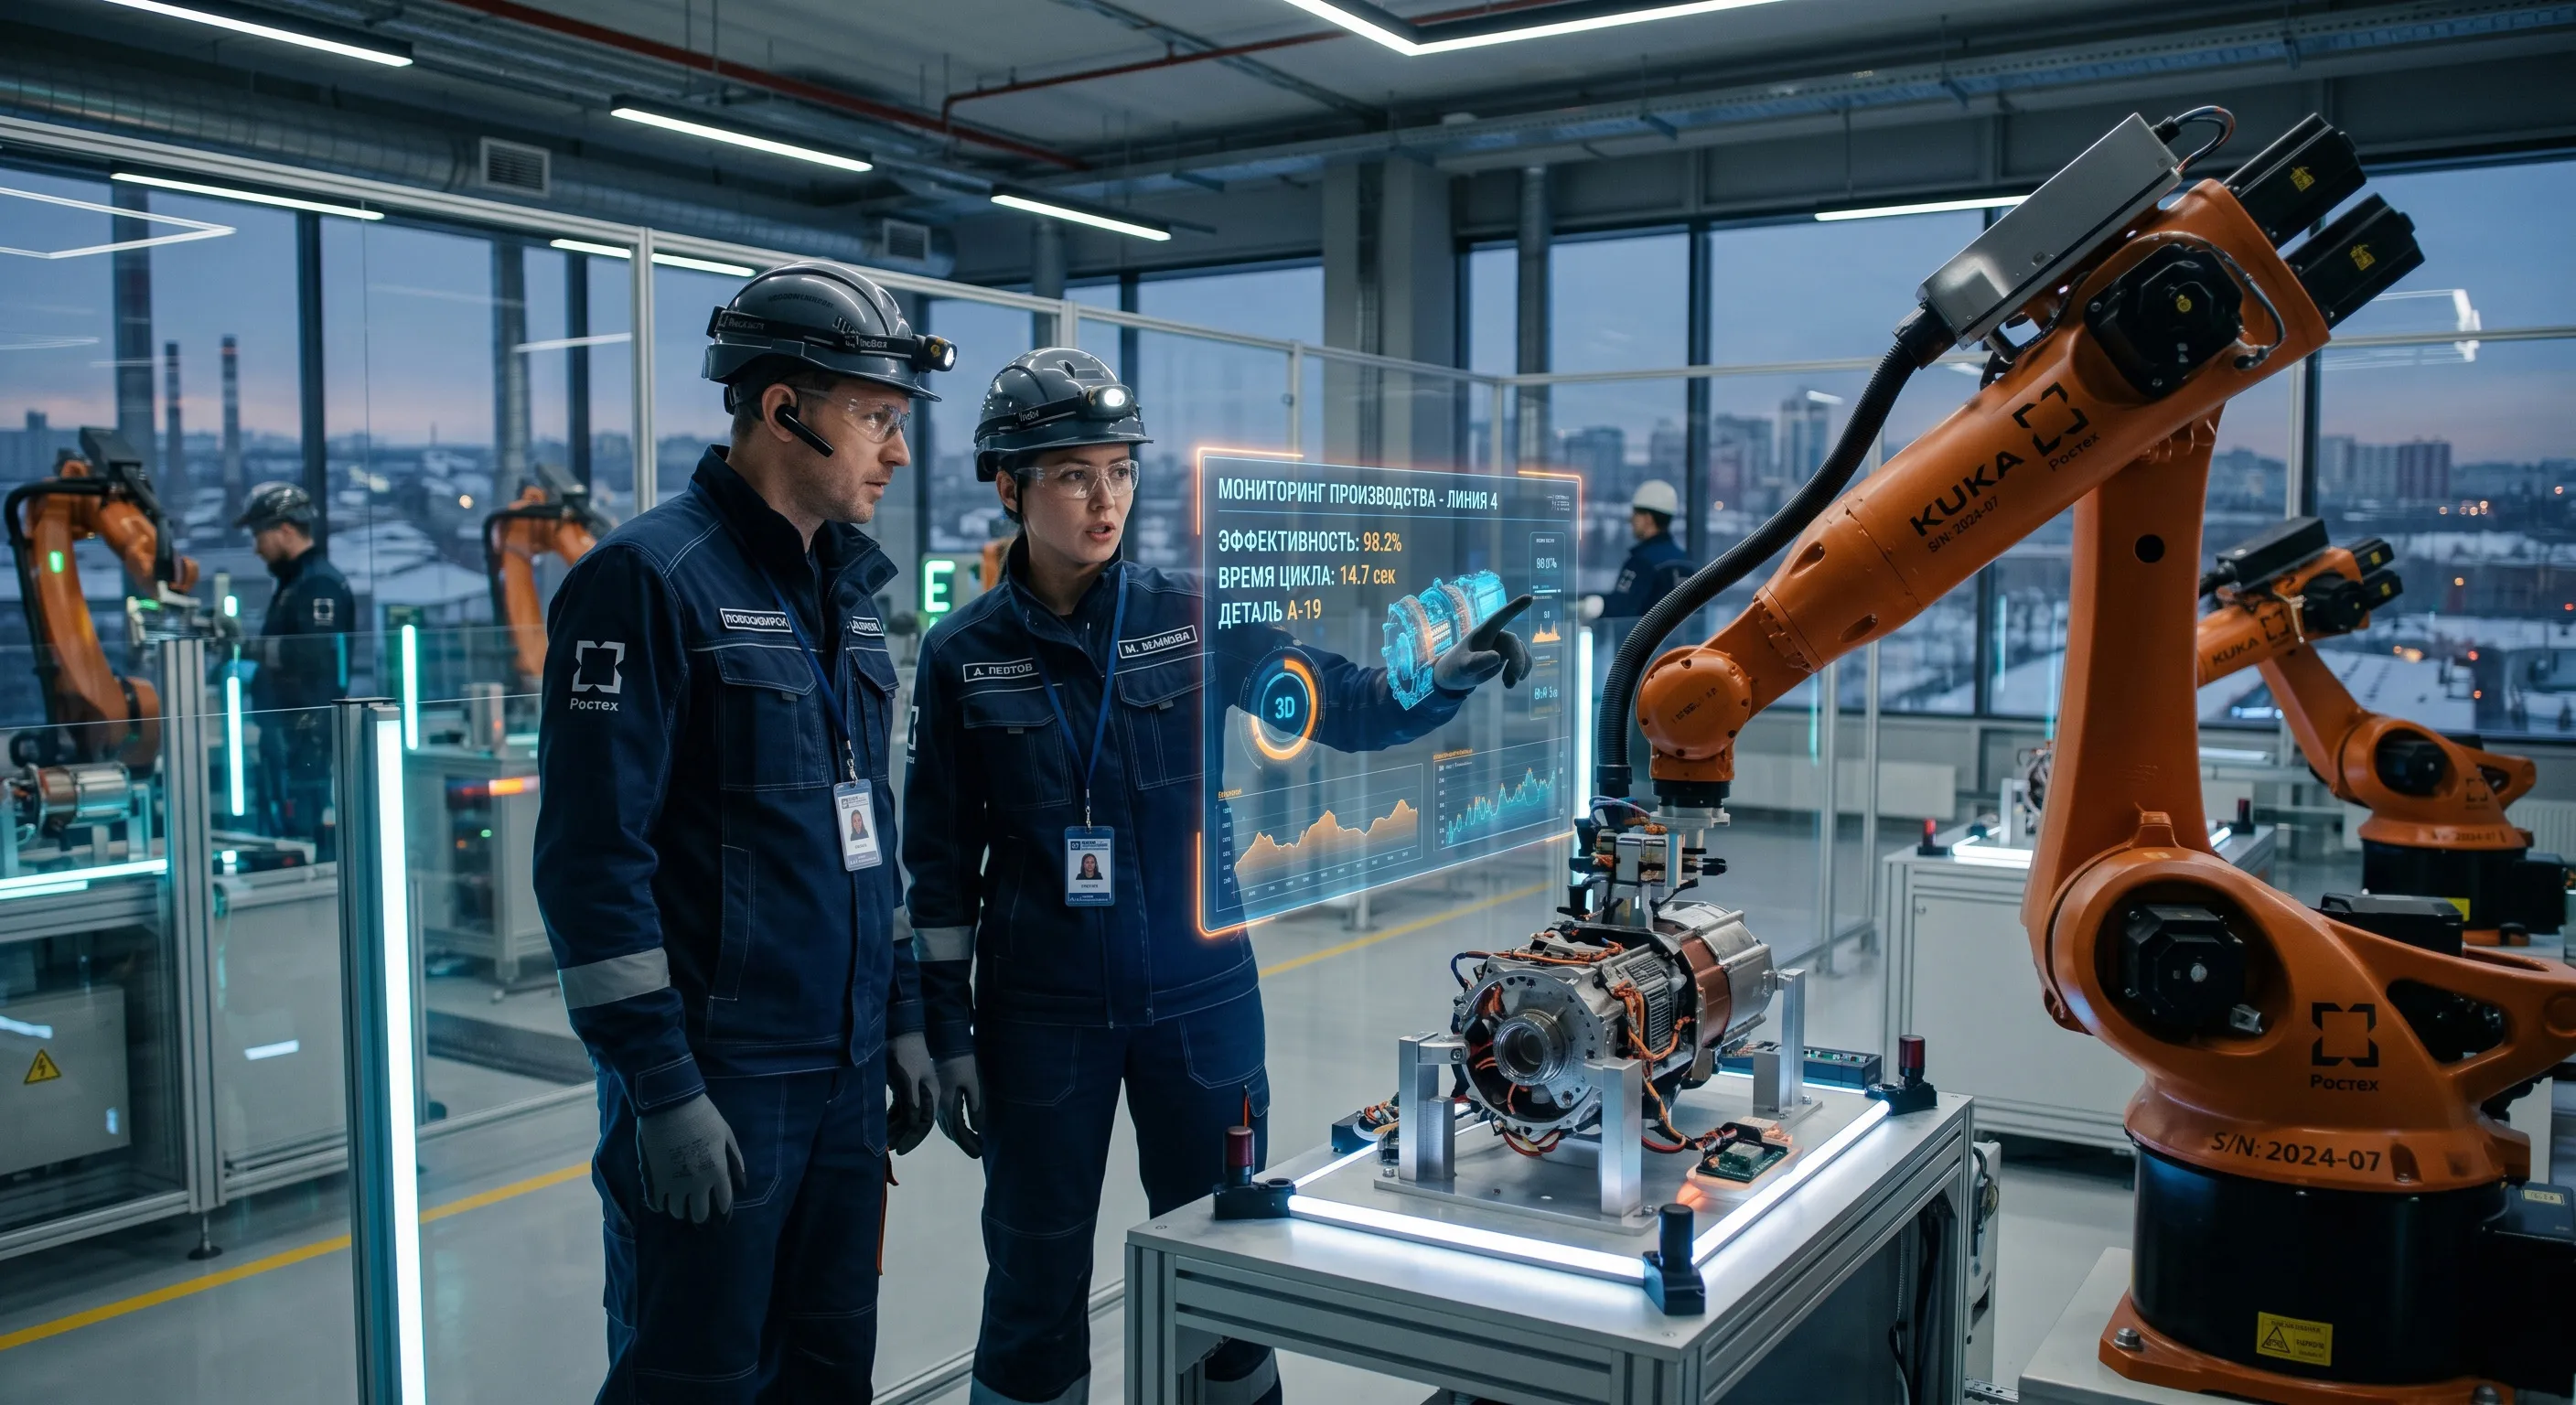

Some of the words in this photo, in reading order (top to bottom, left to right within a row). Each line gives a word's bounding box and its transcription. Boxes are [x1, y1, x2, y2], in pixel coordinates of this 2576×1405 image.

[2048, 432, 2100, 472] Ростех
[1218, 477, 1326, 503] МОНИТОРИНГ
[1330, 483, 1436, 509] ПРОИЗВОДСТВА
[1446, 491, 1487, 509] ЛИНИЯ
[1490, 492, 1498, 509] 4
[1909, 450, 2026, 538] KUKA
[1928, 531, 1954, 552] S/N:
[1952, 495, 2000, 535] 2024-07
[1218, 530, 1359, 552] ЭФФЕКТИВНОСТЬ:
[1363, 531, 1402, 552] 98.2%
[1218, 566, 1274, 589] ВРЕМЯ
[1280, 564, 1336, 591] ЦИКЛА:
[1340, 564, 1370, 585] 14.7
[1373, 569, 1396, 585] сек
[1218, 600, 1283, 630] ДЕТАЛЬ
[1287, 598, 1322, 621] А-19
[570, 697, 619, 712] Ростех
[1274, 696, 1295, 719] 3D
[2310, 1074, 2379, 1092] Ростех
[2211, 1132, 2261, 1158] S/N:
[2266, 1141, 2381, 1172] 2024-07
